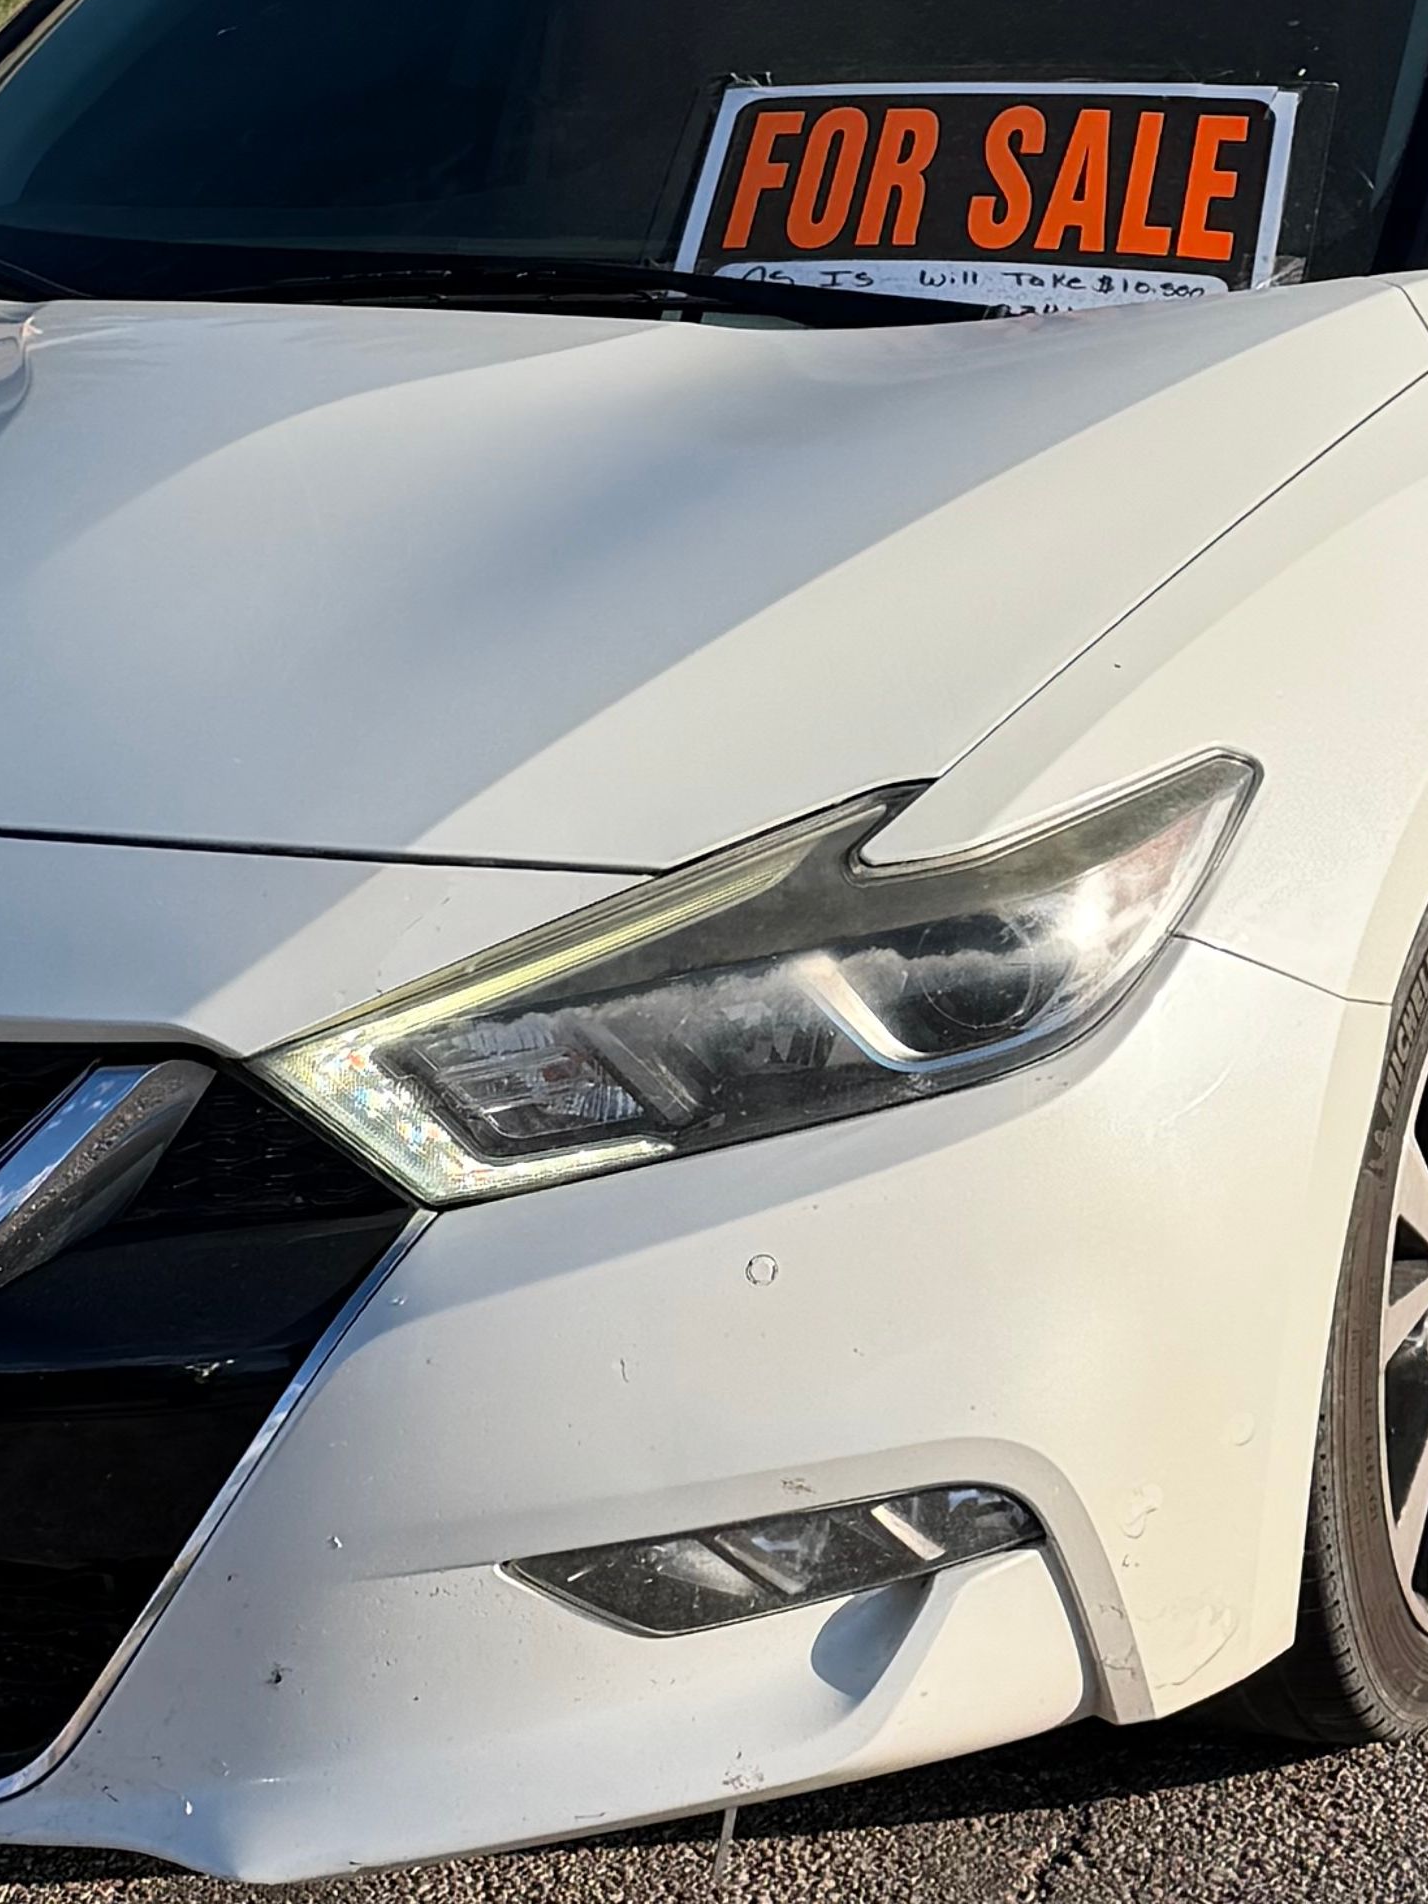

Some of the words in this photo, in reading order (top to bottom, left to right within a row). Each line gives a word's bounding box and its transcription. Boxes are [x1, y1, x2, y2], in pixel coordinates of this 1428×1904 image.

[722, 107, 939, 250] FOR
[967, 105, 1249, 261] SALE
[1002, 272, 1086, 290] Take
